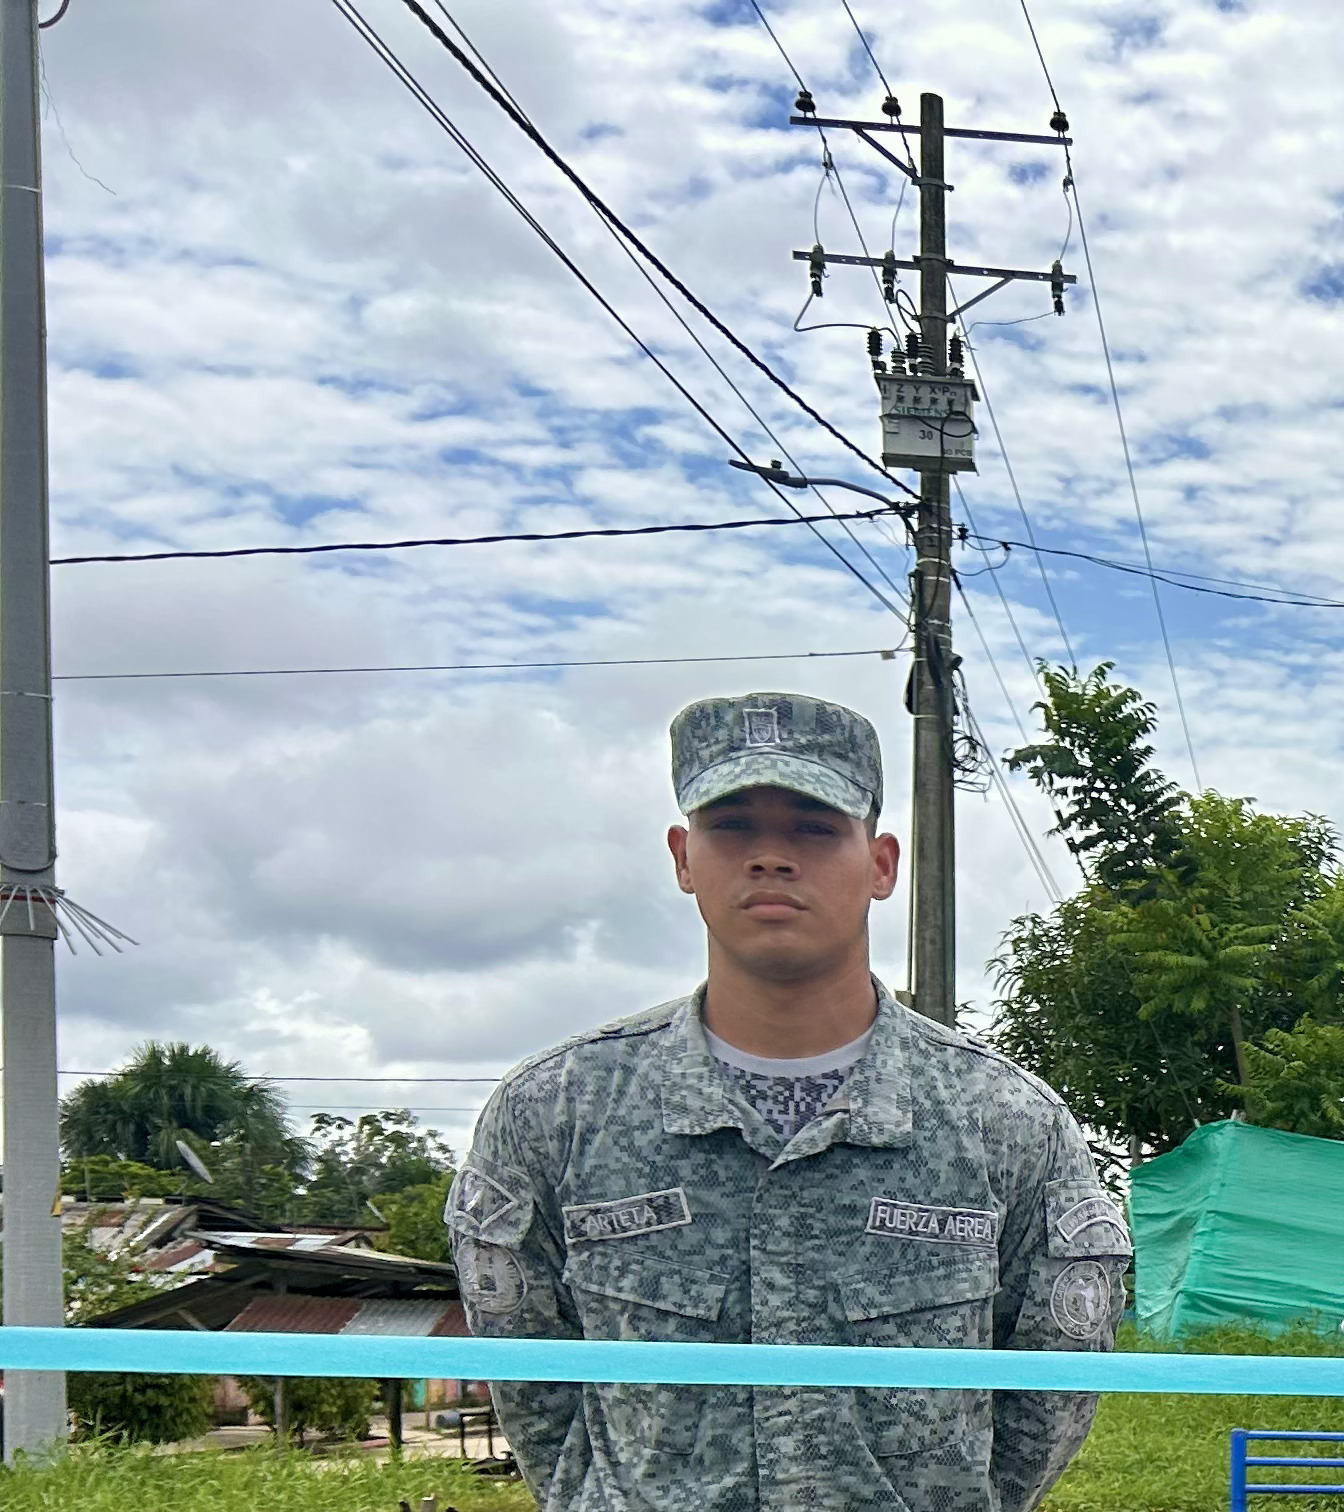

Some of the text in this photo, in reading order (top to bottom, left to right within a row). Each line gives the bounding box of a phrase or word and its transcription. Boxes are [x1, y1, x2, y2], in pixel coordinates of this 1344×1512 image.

[918, 429, 934, 441] 30
[586, 1203, 658, 1235] ARTETA
[875, 1205, 940, 1234] FUERZA
